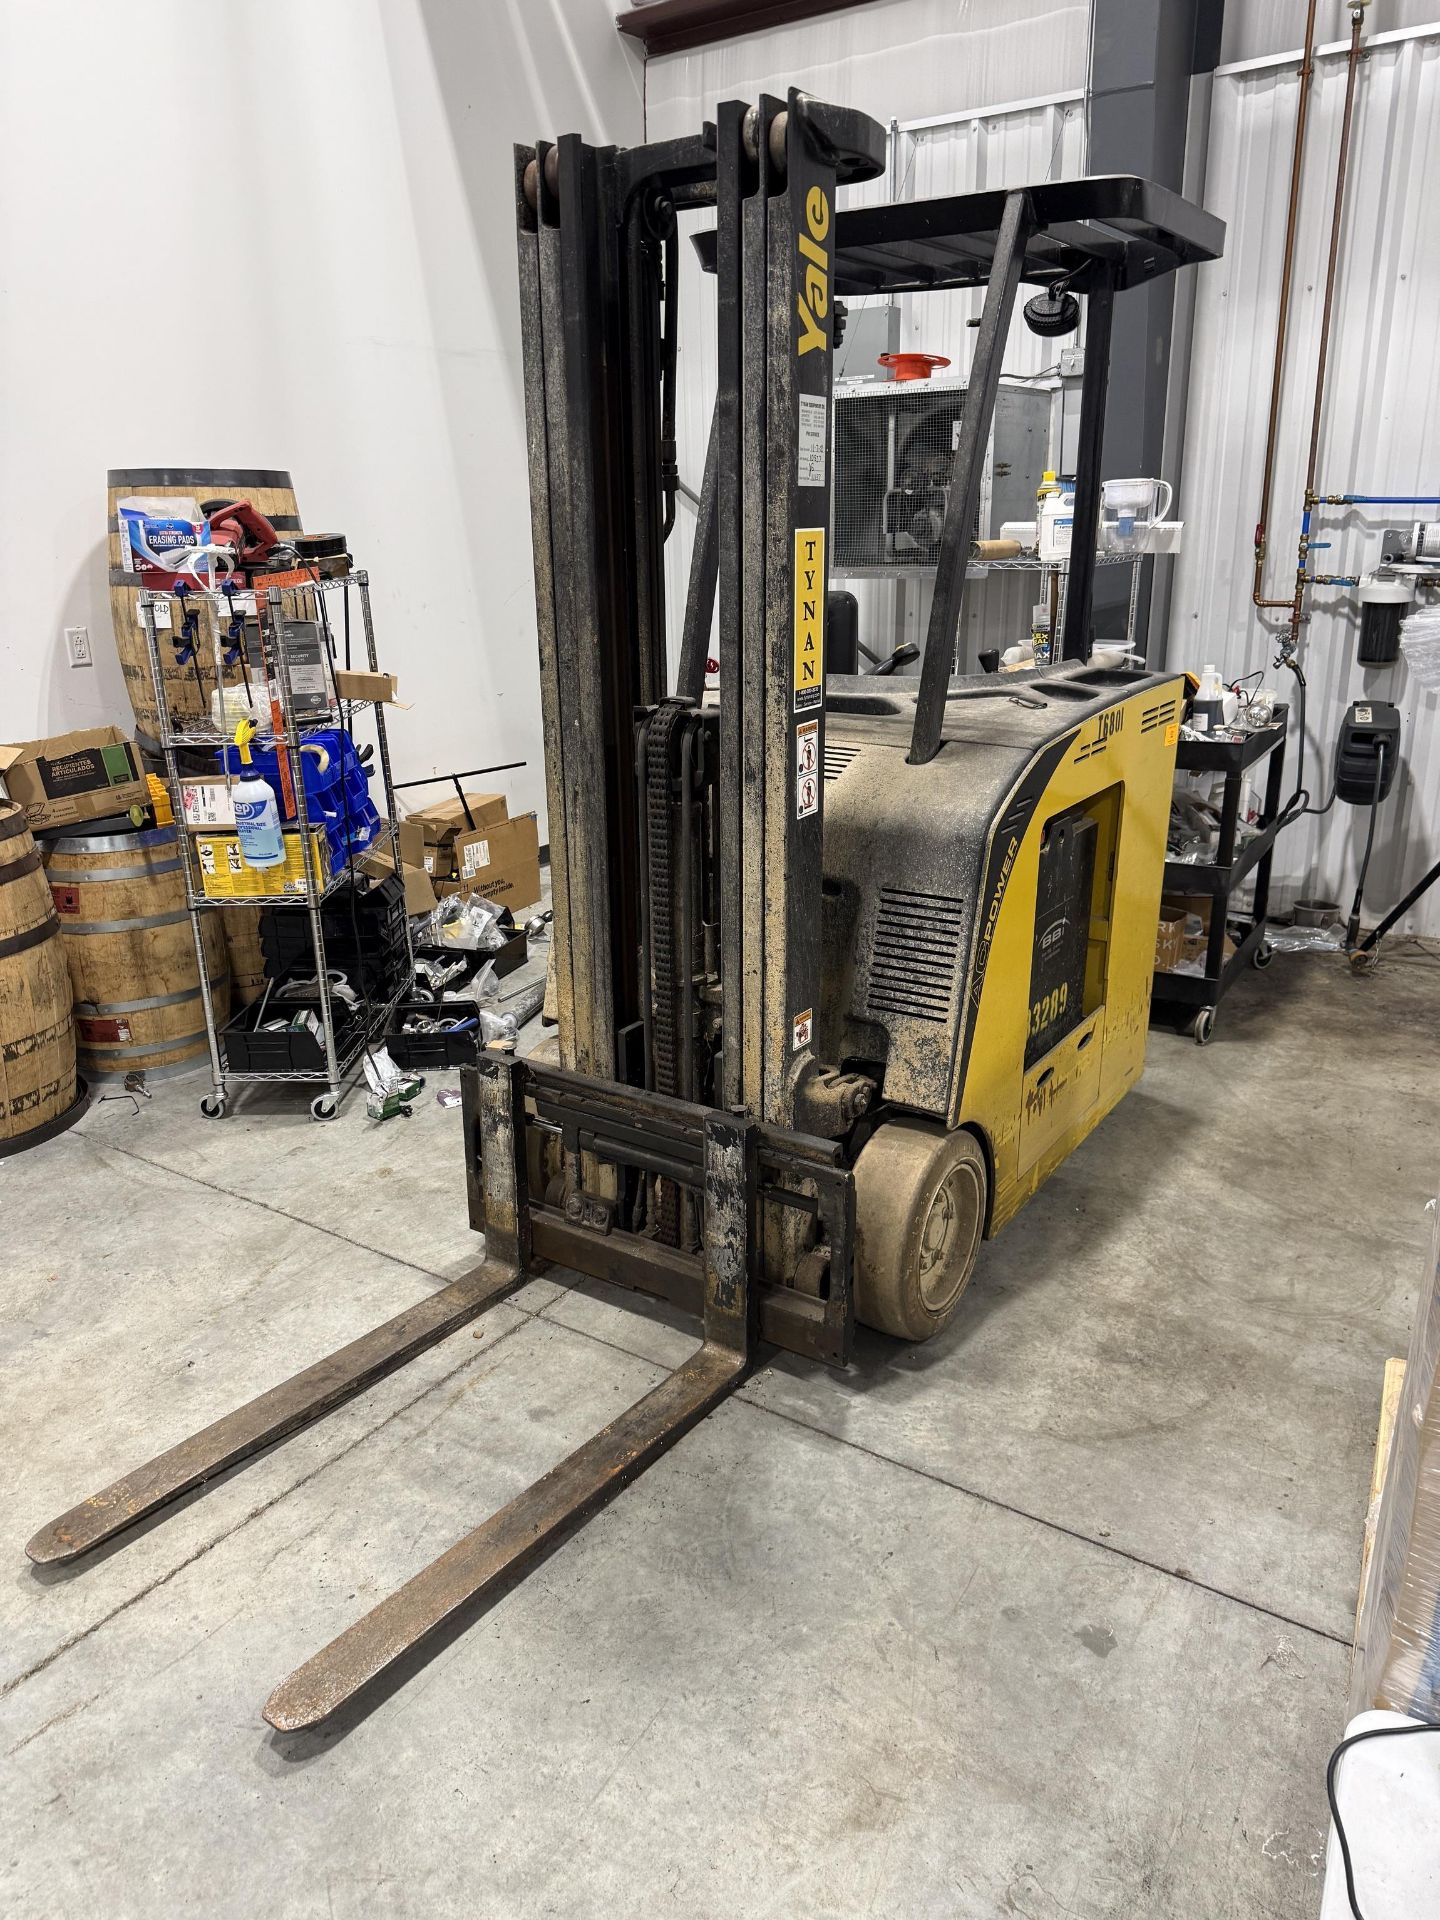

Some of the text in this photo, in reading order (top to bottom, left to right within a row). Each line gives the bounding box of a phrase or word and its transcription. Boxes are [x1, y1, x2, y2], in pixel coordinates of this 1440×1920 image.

[798, 185, 830, 357] Yale
[148, 535, 195, 545] ERASING PADS
[802, 540, 816, 681] TYNAN
[51, 763, 96, 777] ARTICULADOS
